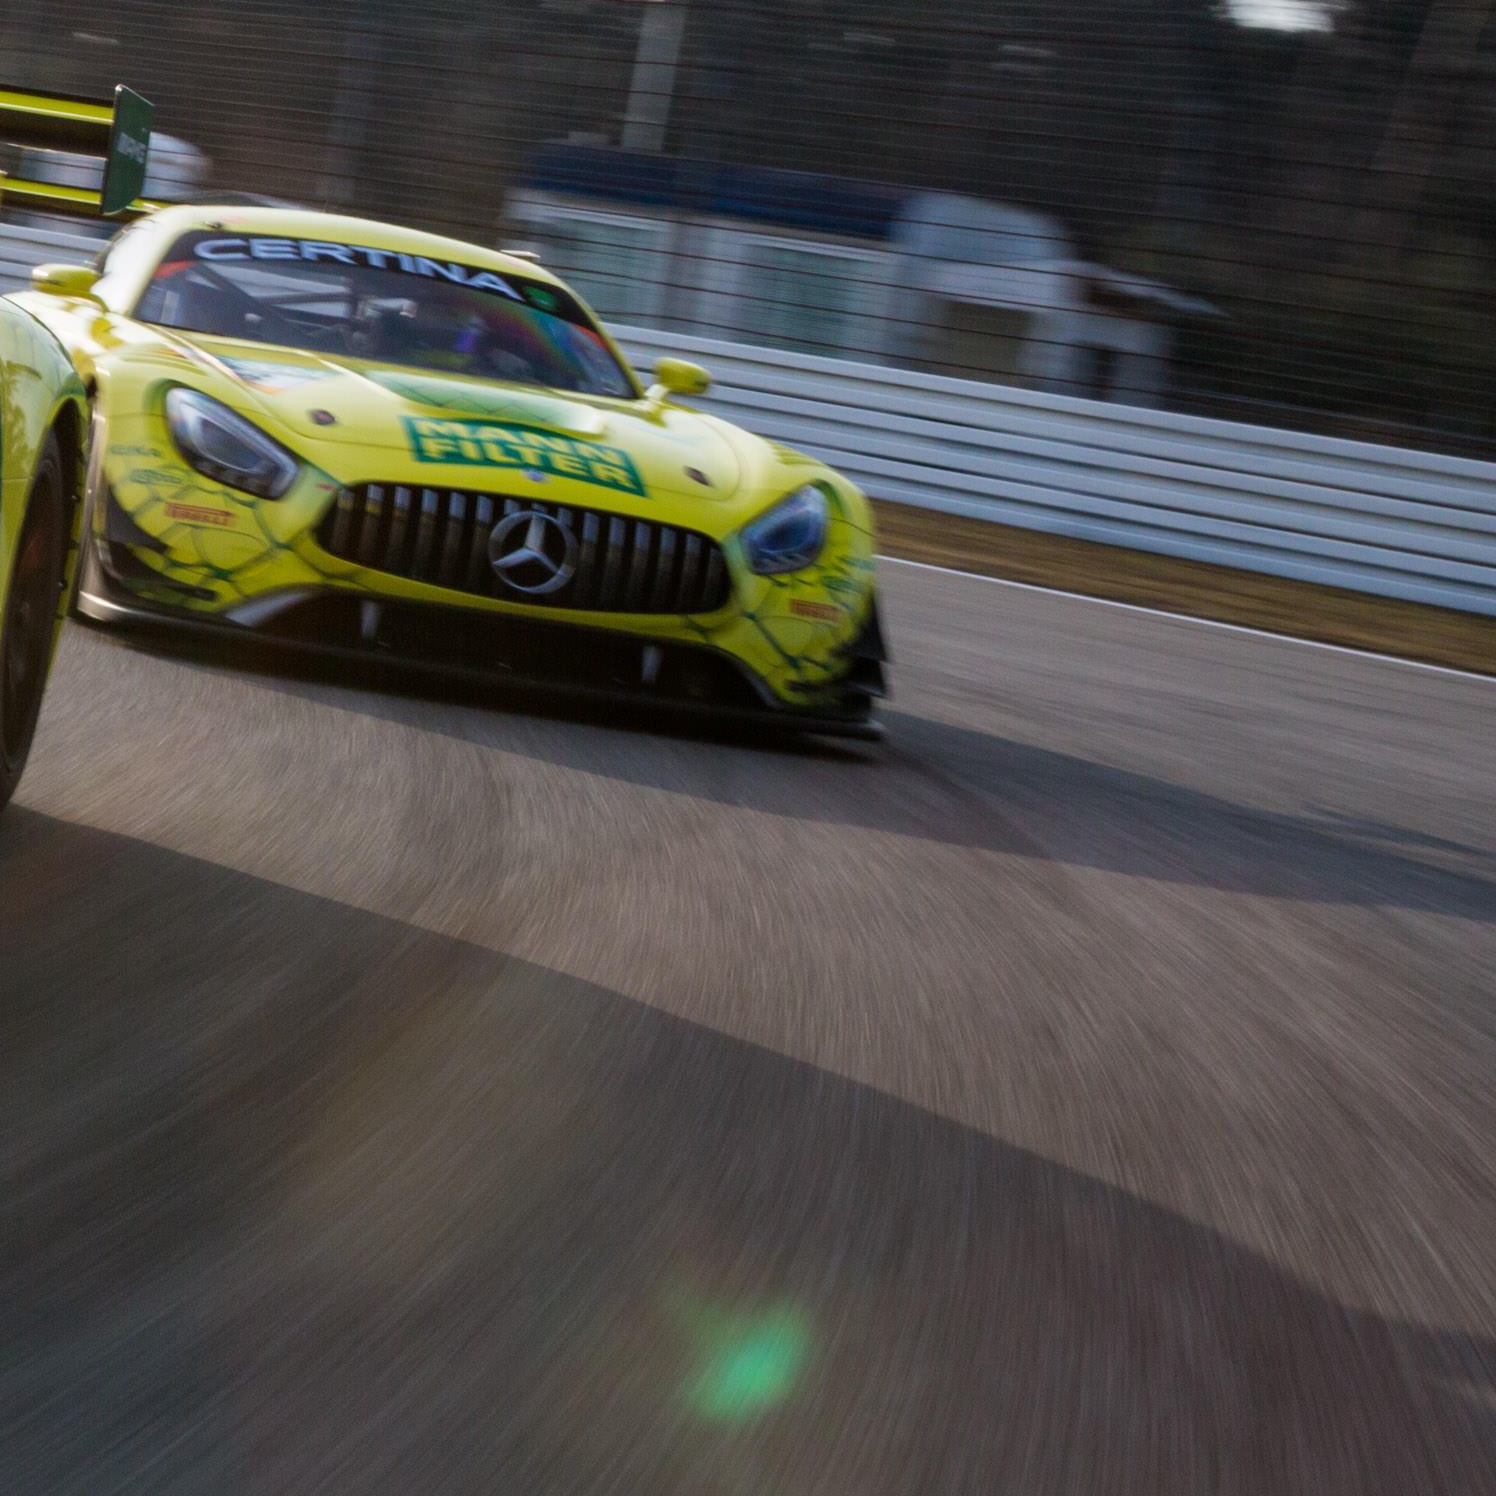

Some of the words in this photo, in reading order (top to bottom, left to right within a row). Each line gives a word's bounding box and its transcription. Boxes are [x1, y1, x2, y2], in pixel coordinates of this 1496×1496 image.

[193, 238, 526, 302] CERTINA
[413, 417, 627, 467] MANN
[419, 436, 636, 490] FILTER
